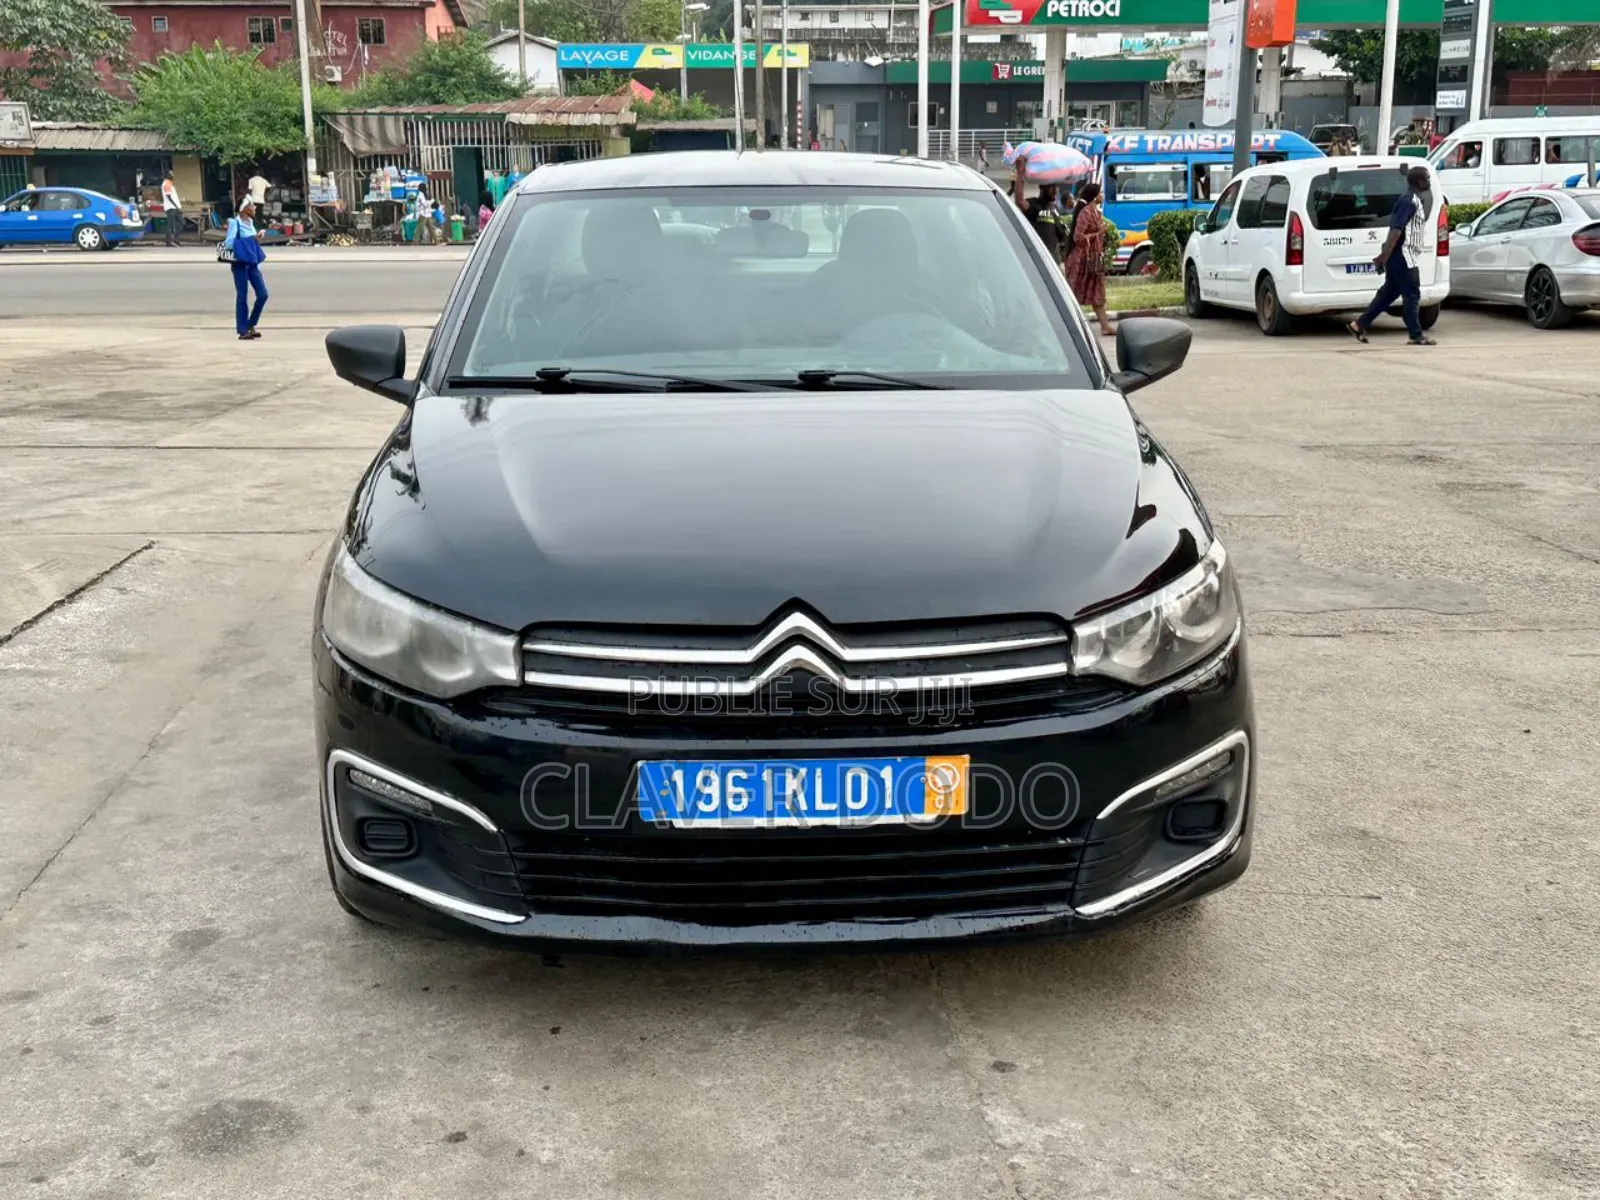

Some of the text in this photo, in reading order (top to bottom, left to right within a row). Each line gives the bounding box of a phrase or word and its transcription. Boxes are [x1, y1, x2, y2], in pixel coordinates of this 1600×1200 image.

[1046, 0, 1121, 18] PETROCI
[560, 49, 629, 62] LAVAGE
[1023, 65, 1045, 76] GRE
[1105, 133, 1281, 153] KF TRANSPRT
